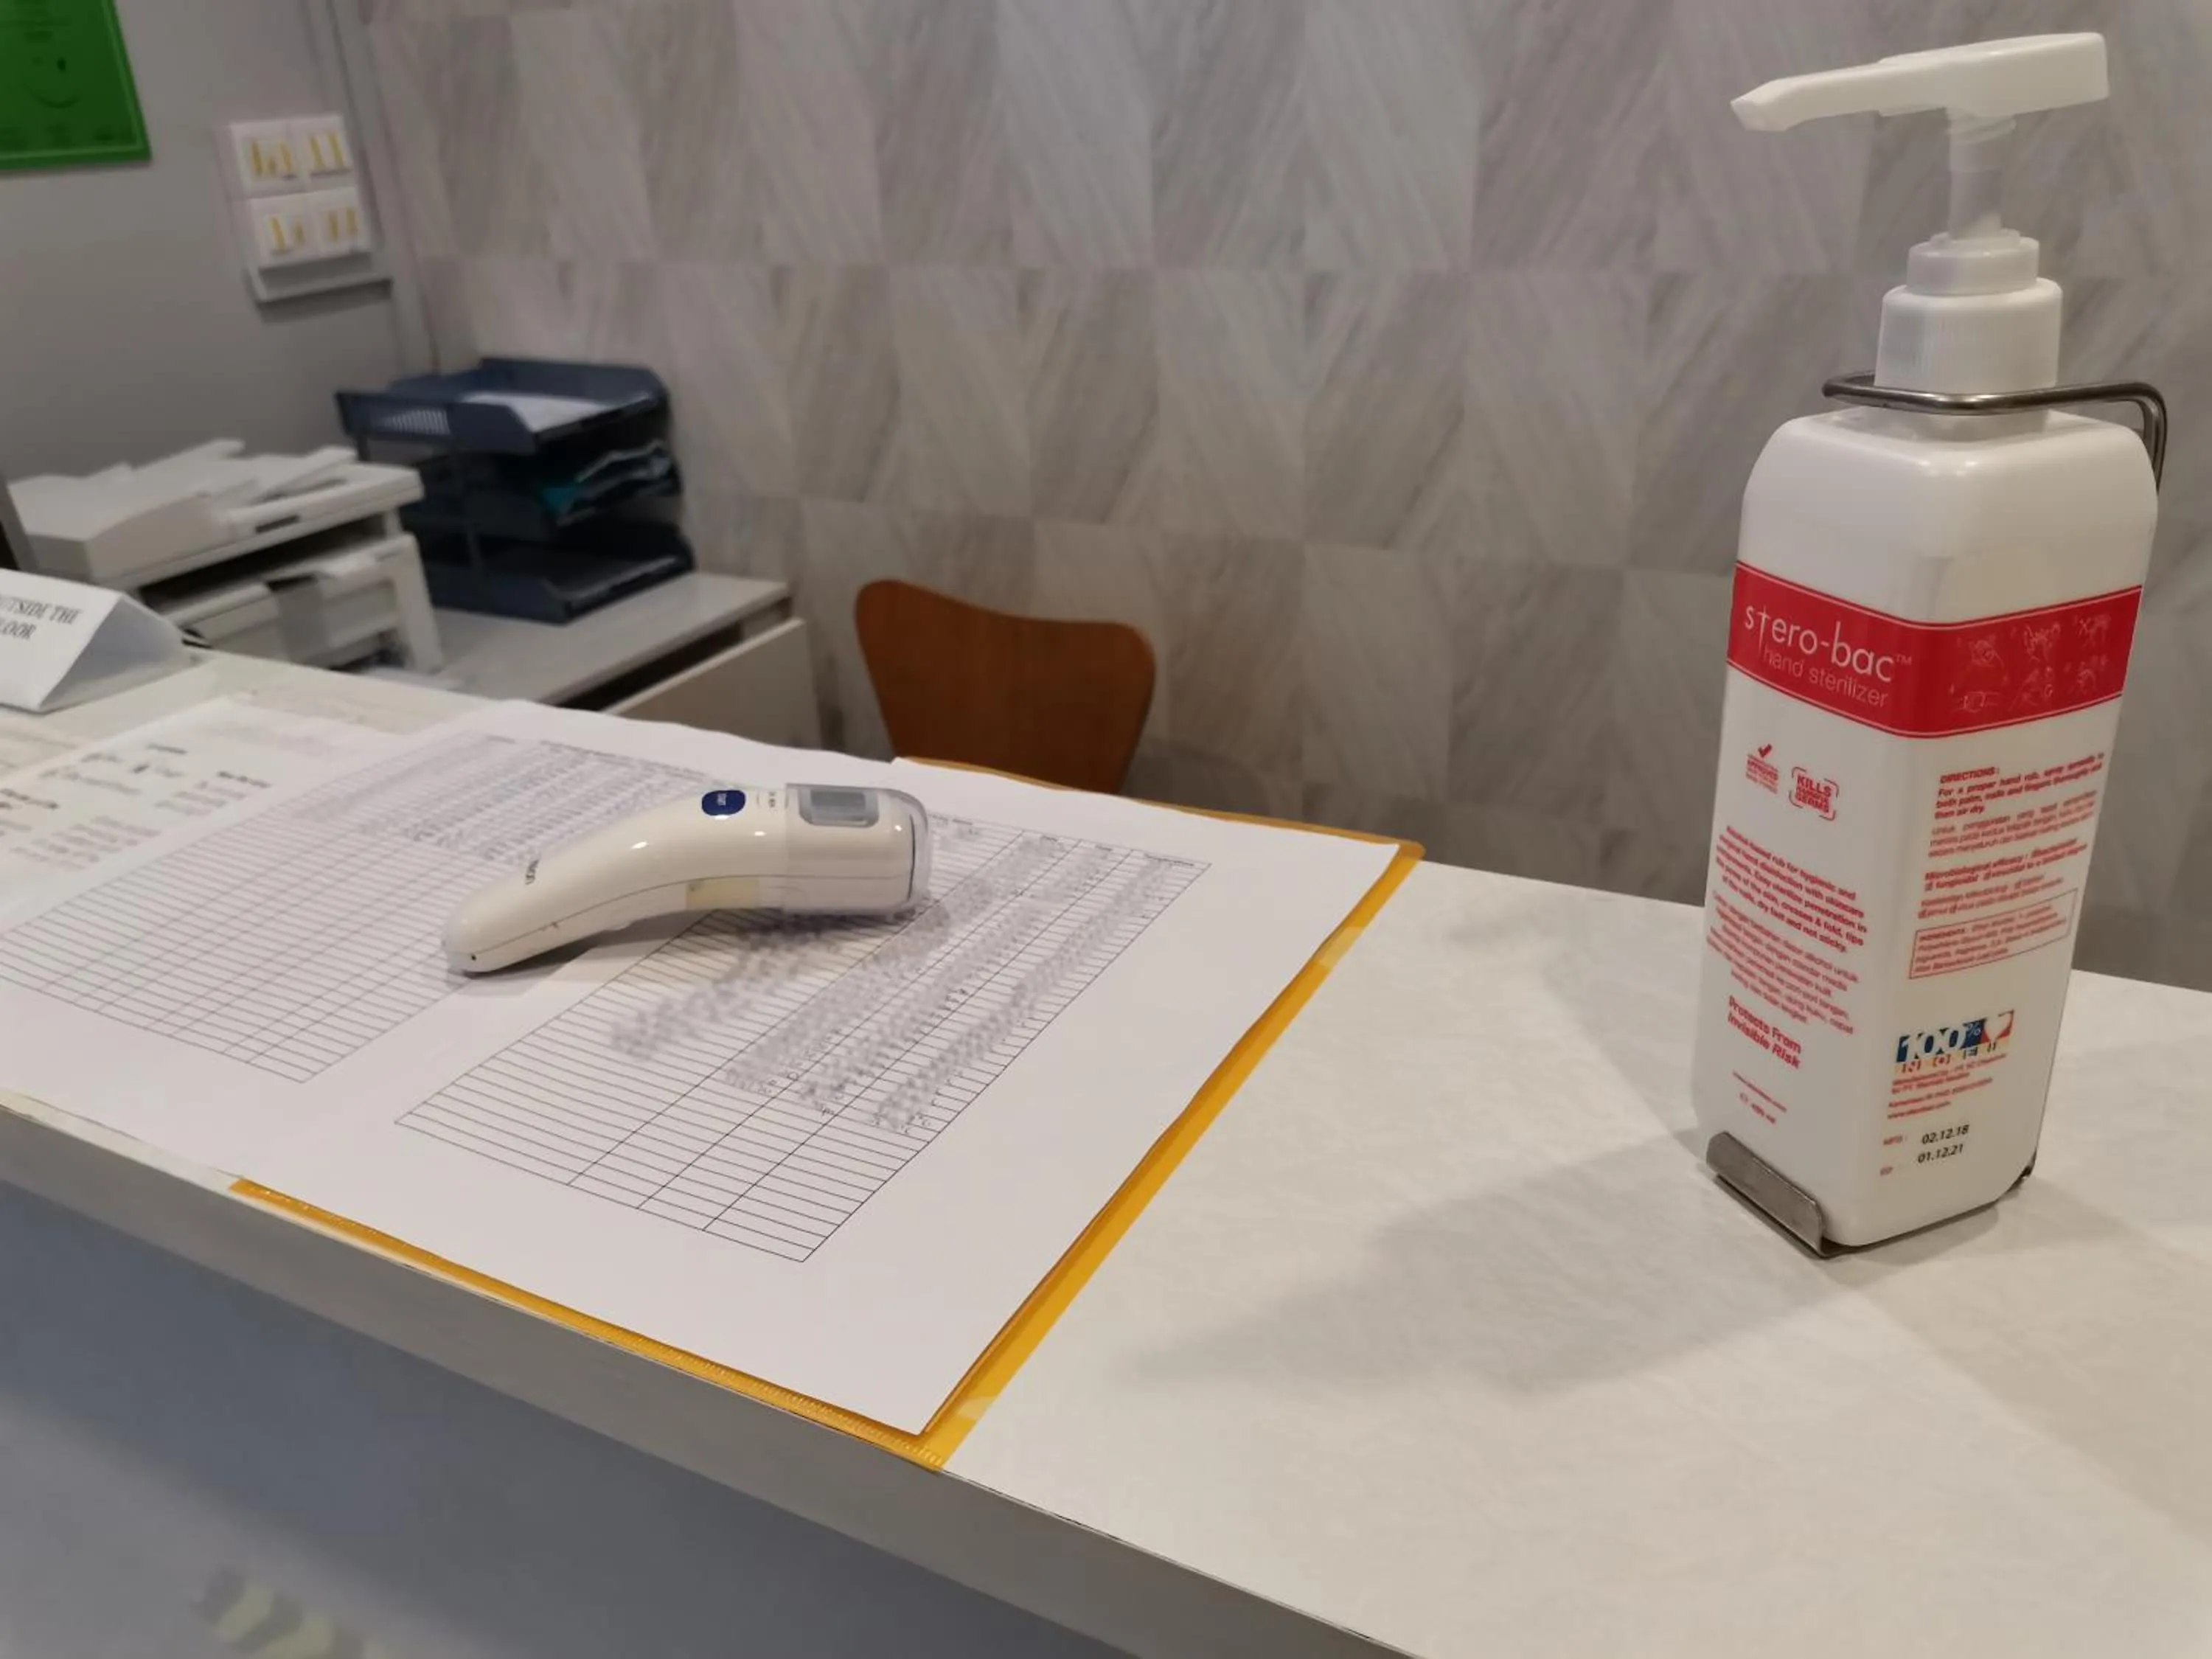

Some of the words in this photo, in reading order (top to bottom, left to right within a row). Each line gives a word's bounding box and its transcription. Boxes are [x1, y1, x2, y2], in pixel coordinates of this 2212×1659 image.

[1745, 605, 1894, 682] stero-bac
[1763, 645, 1804, 678] hand
[1809, 667, 1889, 708] sterilizer
[1797, 774, 1832, 798] KILLS
[1728, 1011, 1770, 1051] Invisible
[1772, 1042, 1801, 1070] Risk
[1729, 994, 1770, 1034] Protects
[1772, 1026, 1802, 1055] From
[1918, 1144, 1964, 1164] 01.12.21
[1921, 1124, 1970, 1145] 02.12.18
